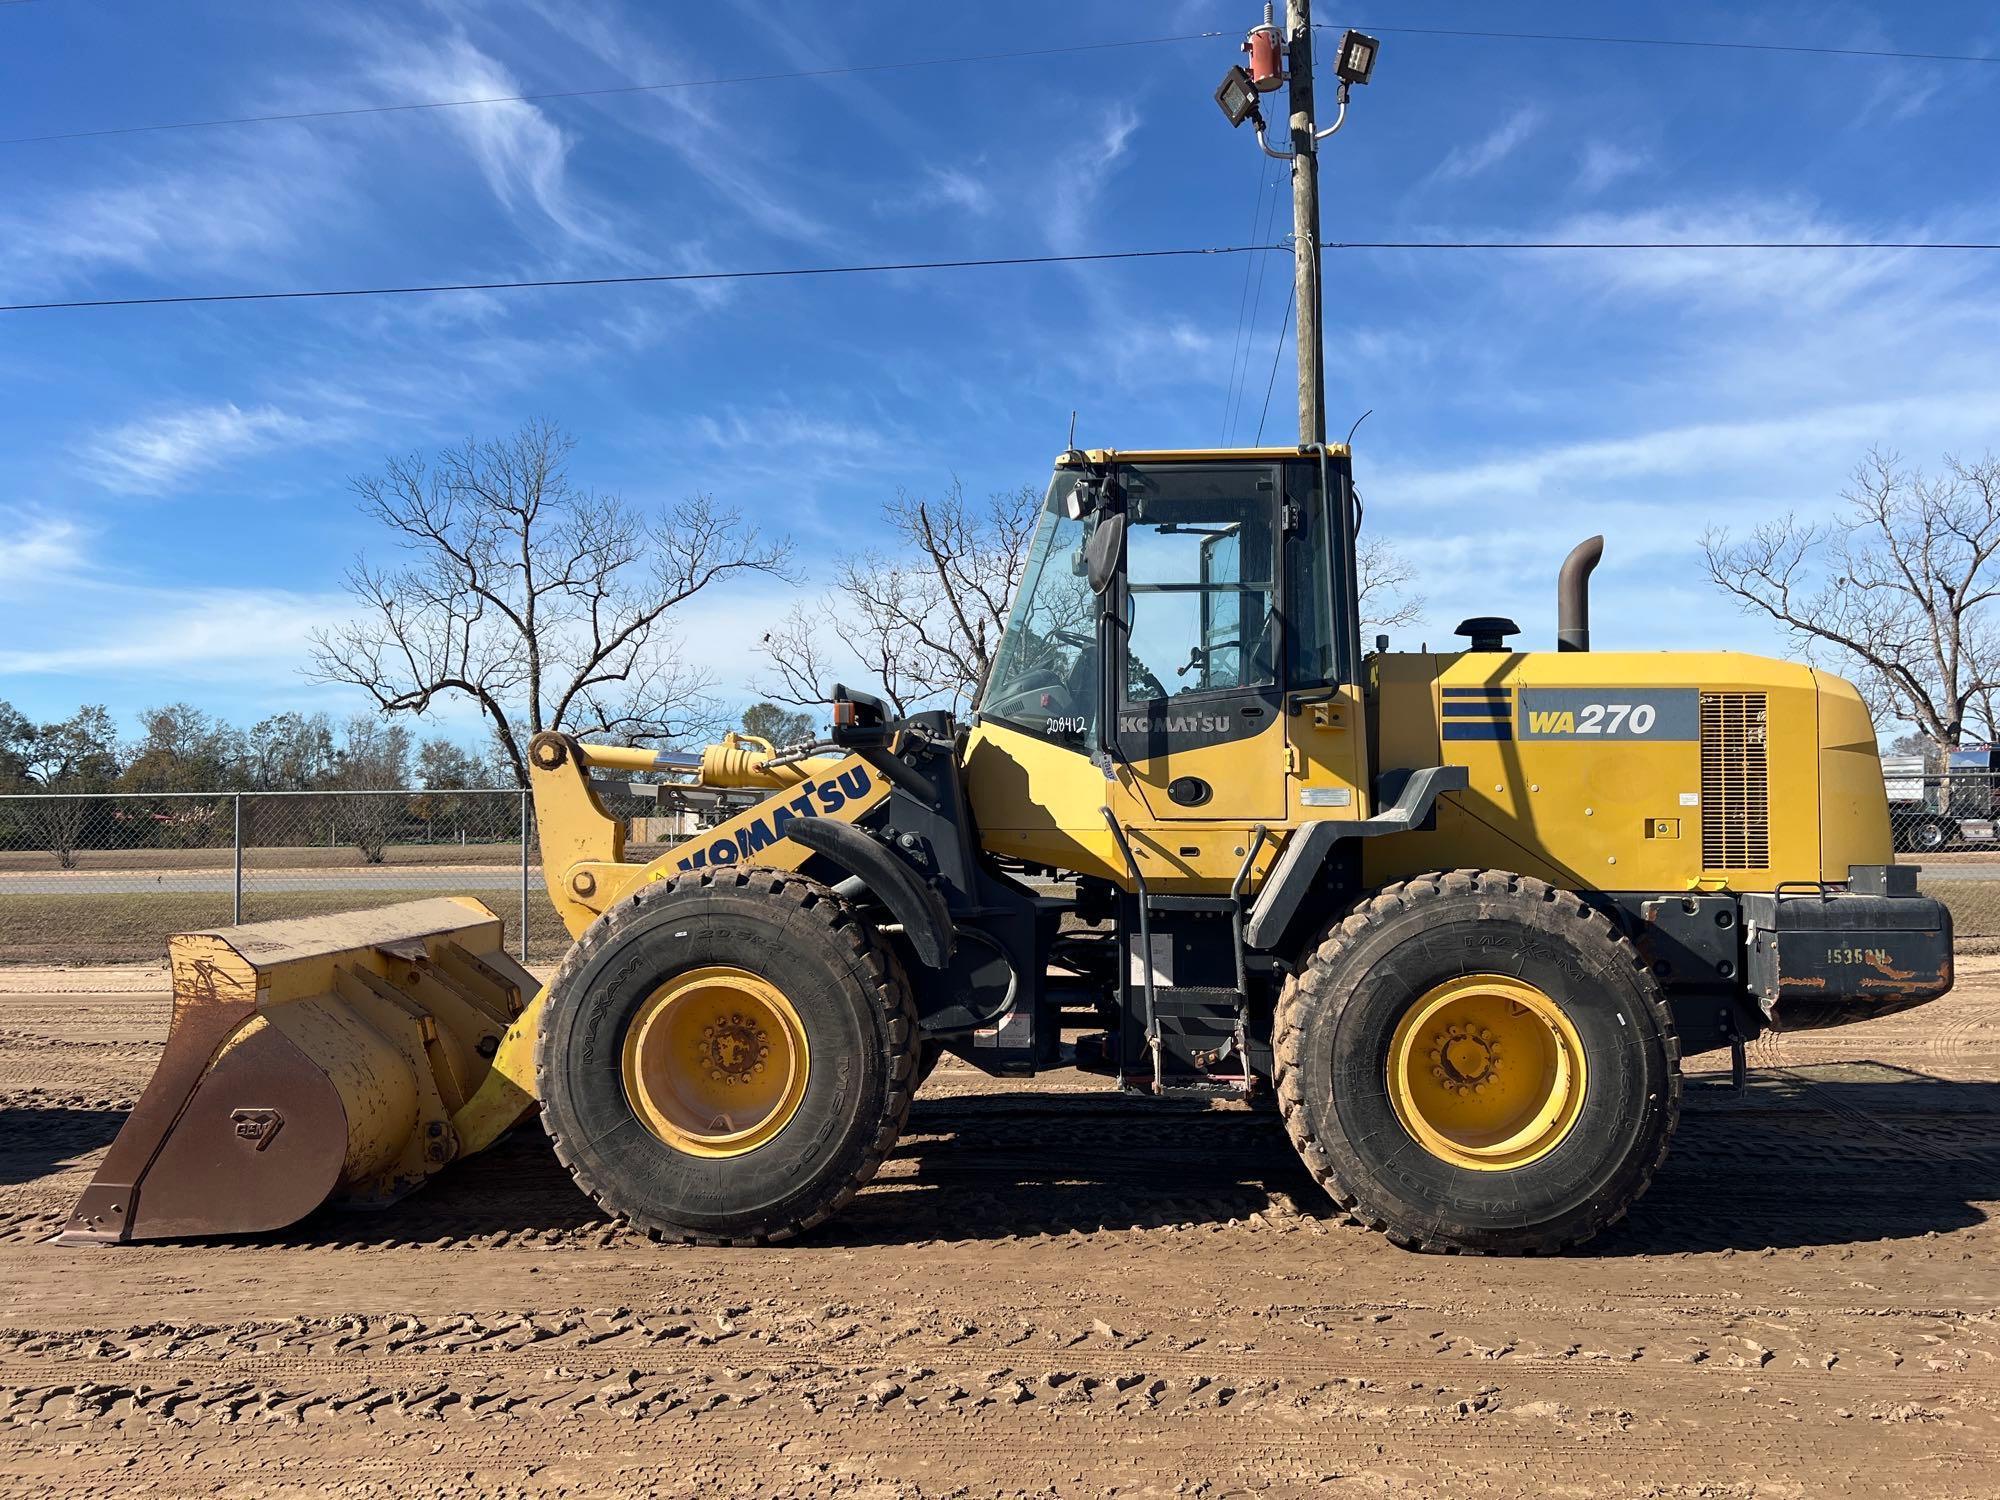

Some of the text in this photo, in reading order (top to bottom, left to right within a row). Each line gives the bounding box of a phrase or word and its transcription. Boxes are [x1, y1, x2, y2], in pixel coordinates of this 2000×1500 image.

[1046, 716, 1088, 735] 208412
[1120, 712, 1230, 733] KOMATSU
[1529, 704, 1656, 734] WA270
[583, 955, 644, 1065] MAXAM
